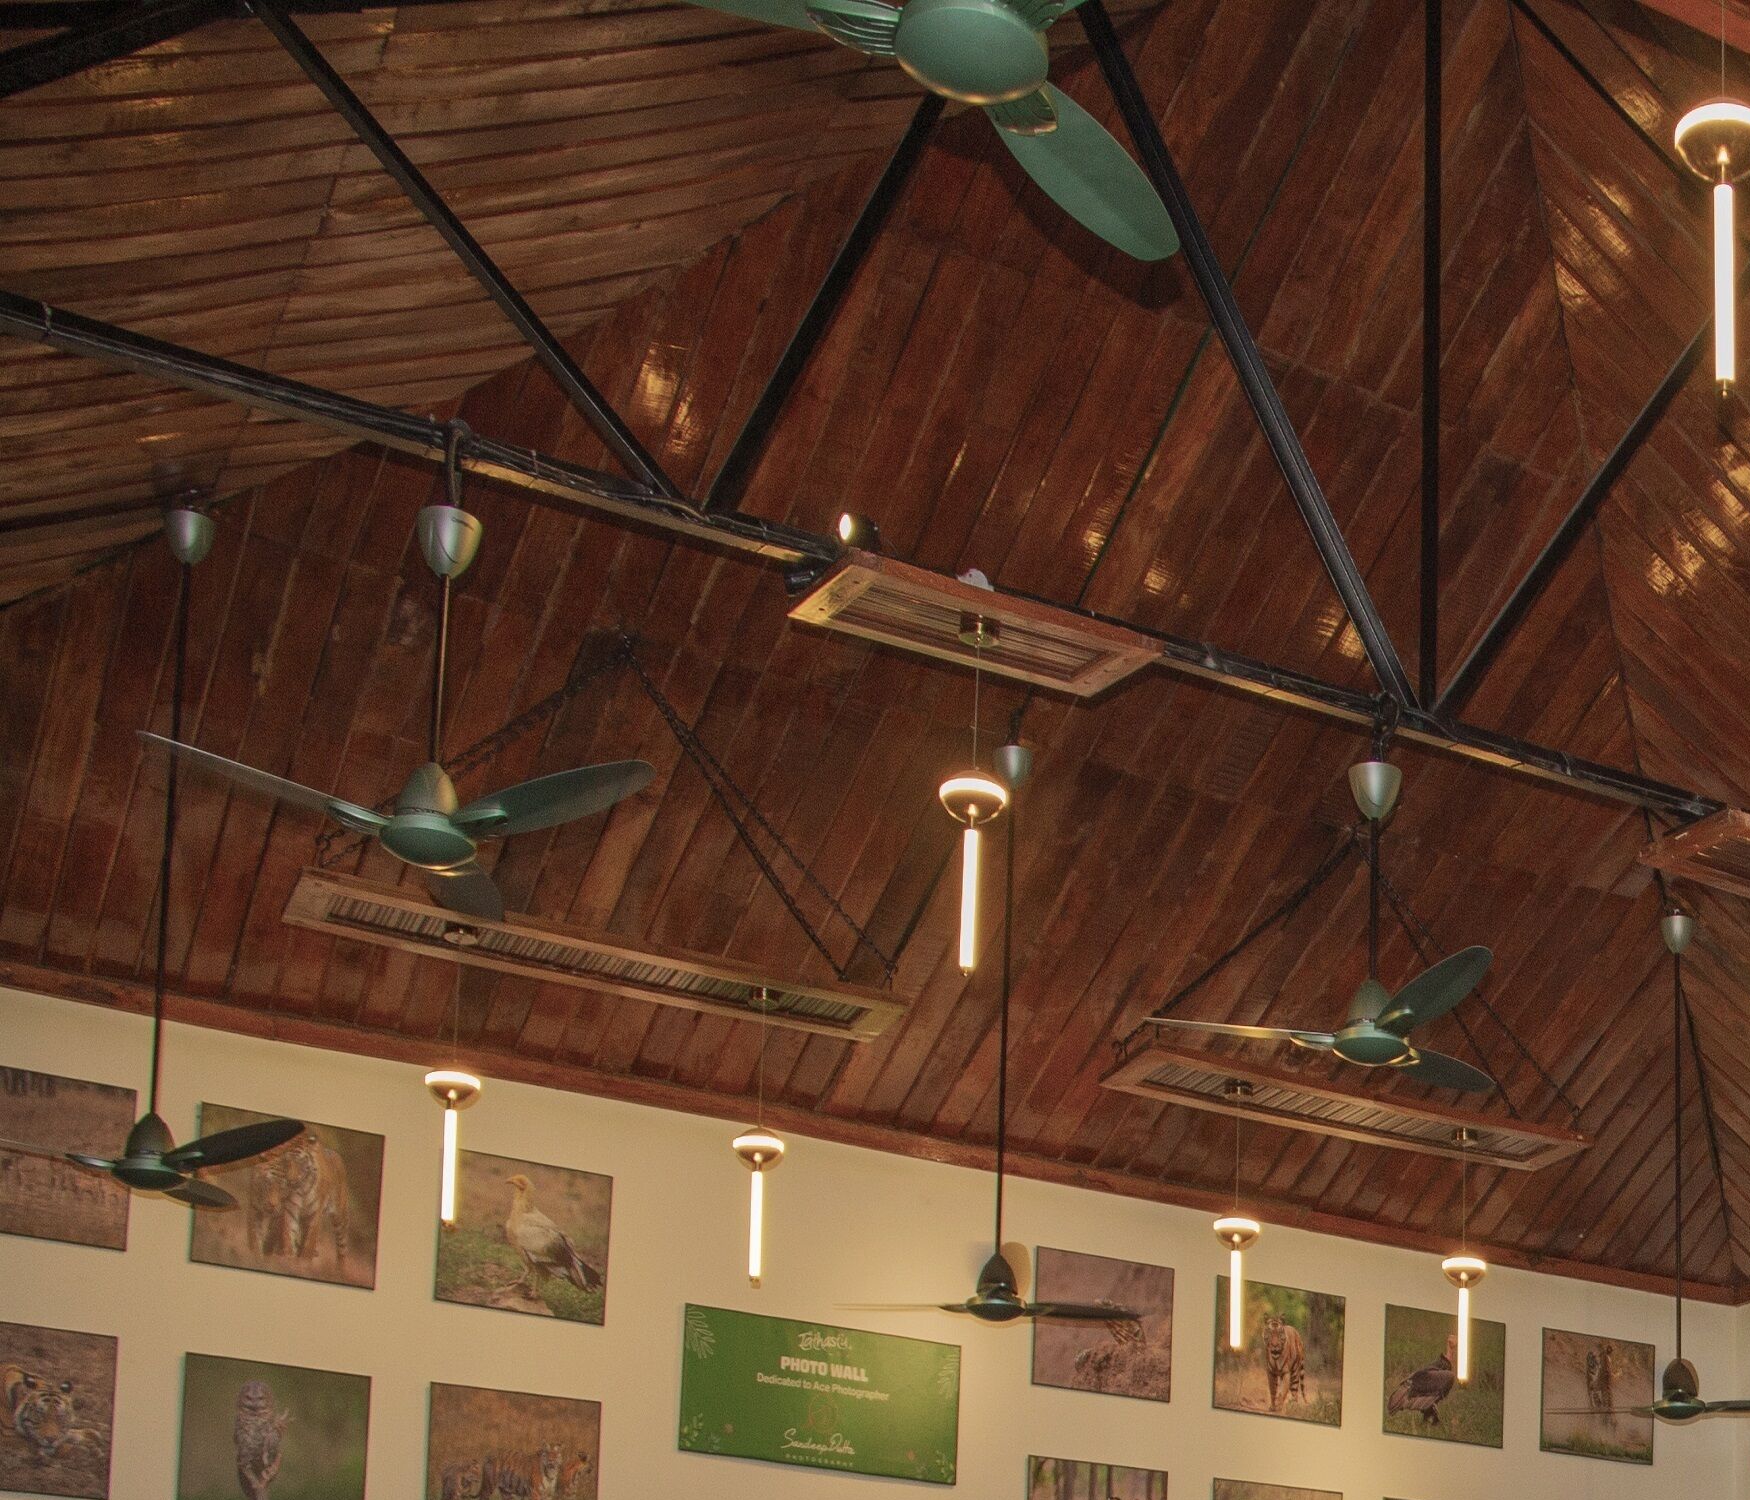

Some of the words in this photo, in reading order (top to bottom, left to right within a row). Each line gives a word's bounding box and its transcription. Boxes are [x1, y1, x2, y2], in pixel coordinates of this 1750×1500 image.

[780, 1356, 828, 1376] PHOTO
[830, 1363, 869, 1382] WALL
[757, 1372, 802, 1388] Dedicated
[803, 1381, 812, 1389] to
[813, 1381, 831, 1392] Ace
[831, 1383, 890, 1401] Photographer
